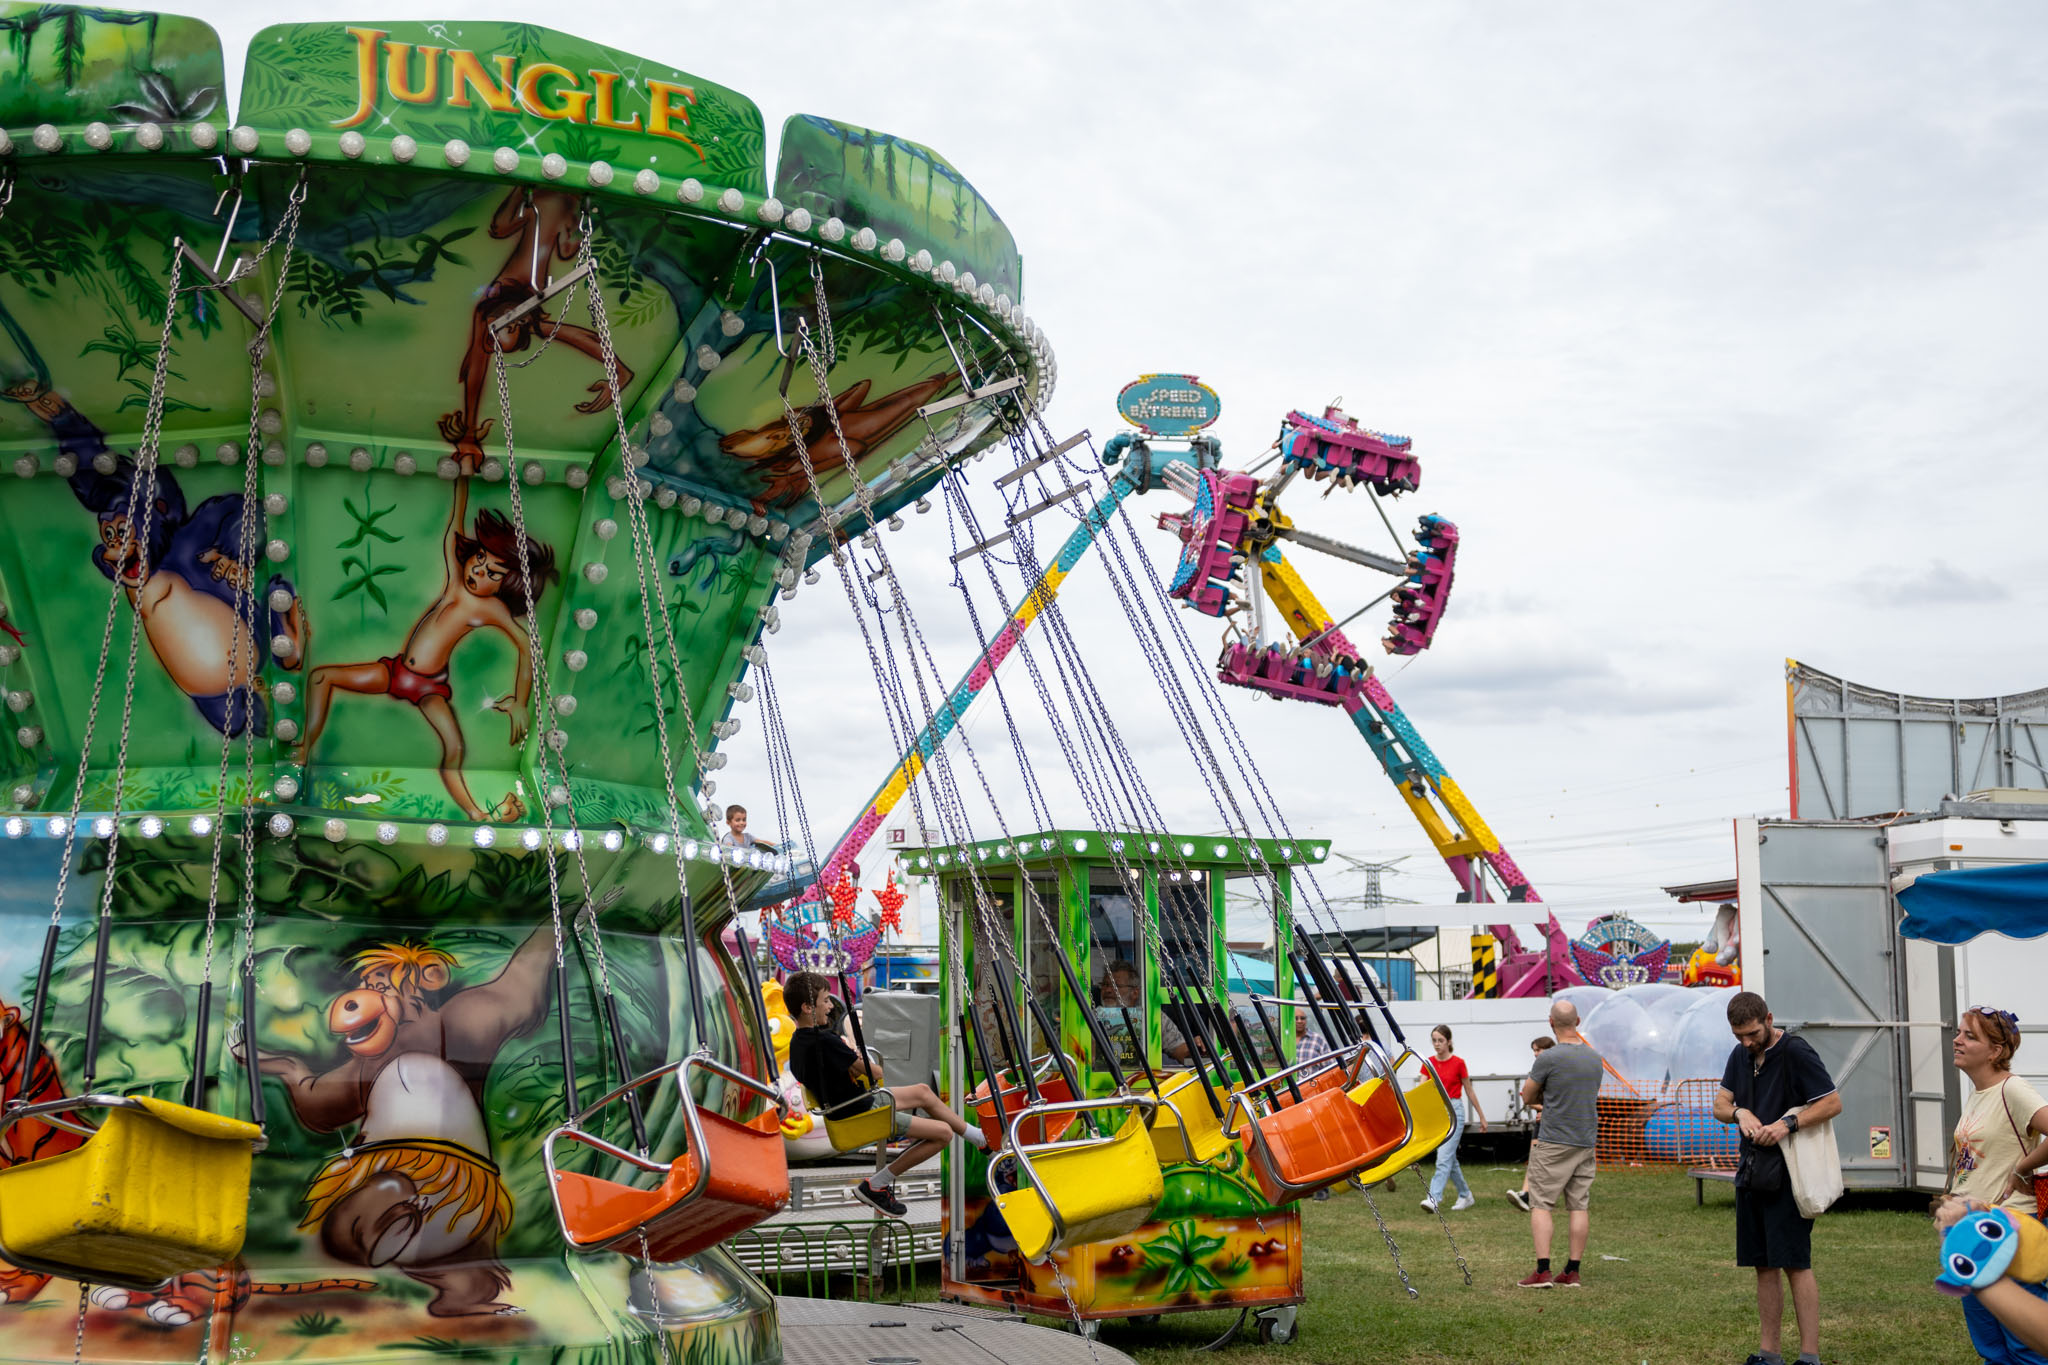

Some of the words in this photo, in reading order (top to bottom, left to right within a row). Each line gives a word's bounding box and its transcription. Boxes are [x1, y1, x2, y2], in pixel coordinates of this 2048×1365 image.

[329, 26, 706, 166] JUNGLE
[1149, 389, 1202, 403] SPEED
[1130, 397, 1207, 419] EXTREME
[895, 831, 902, 841] 2
